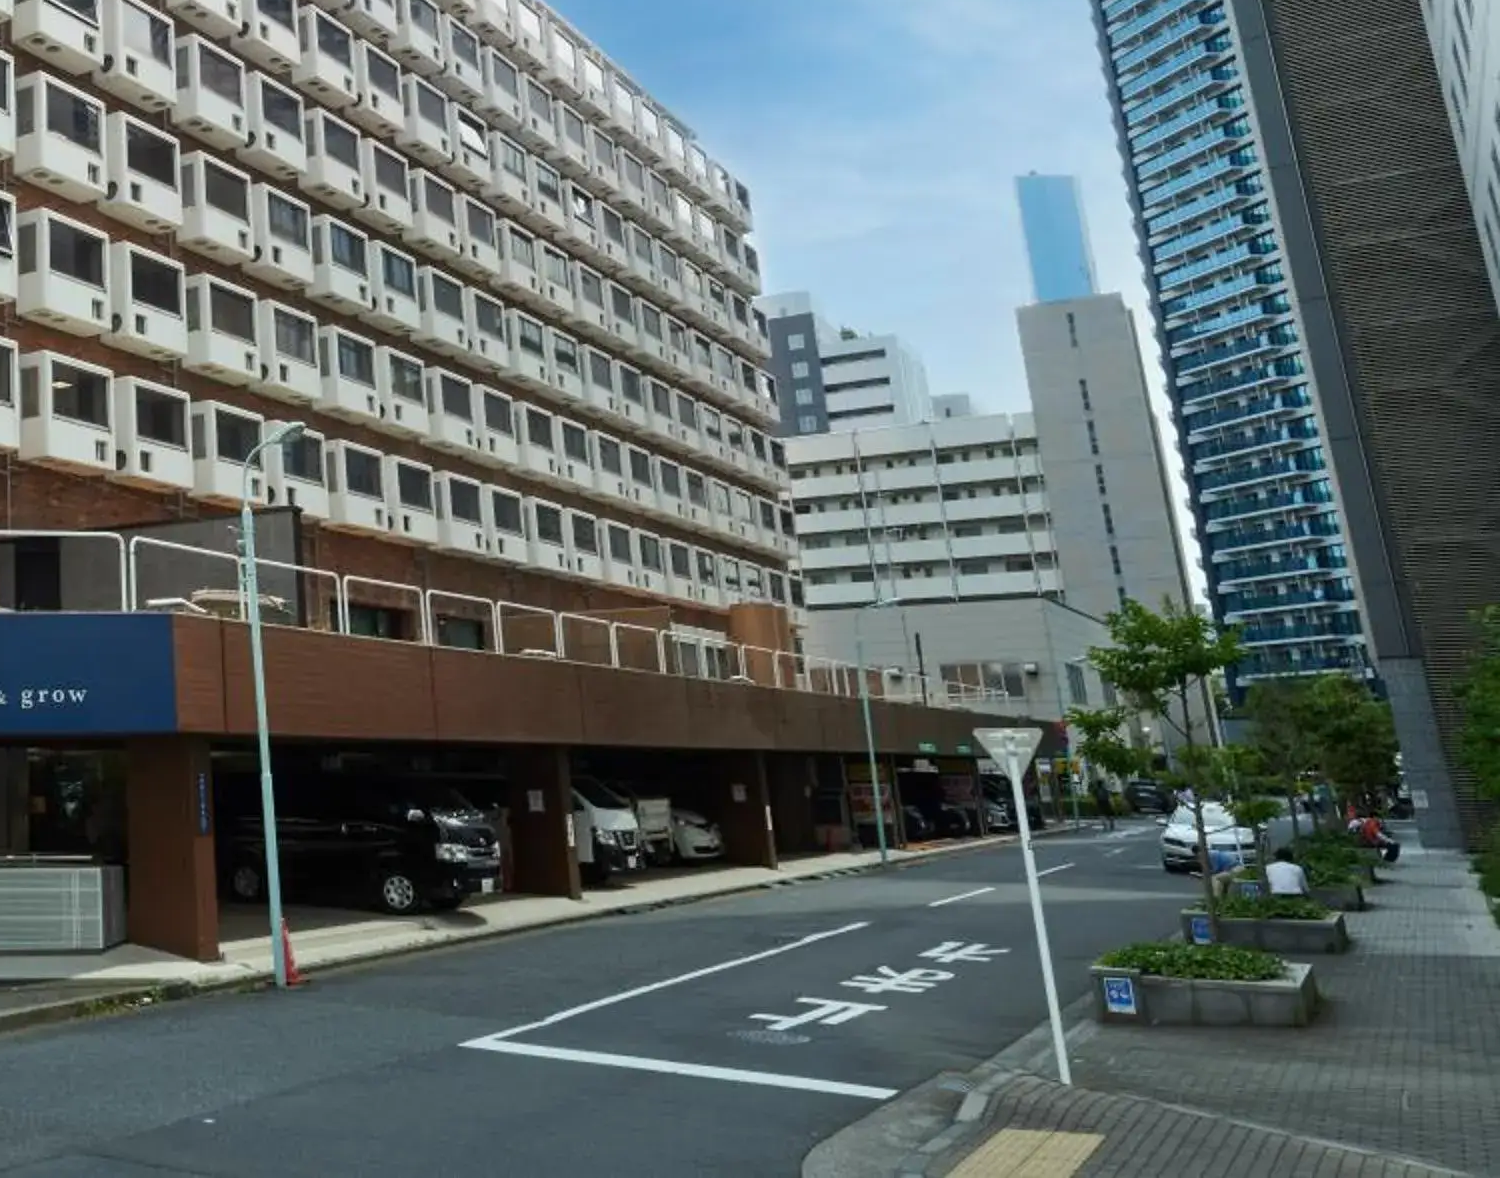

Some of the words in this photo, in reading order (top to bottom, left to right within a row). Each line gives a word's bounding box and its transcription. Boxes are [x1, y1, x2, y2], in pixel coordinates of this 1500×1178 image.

[21, 688, 88, 709] grow
[748, 940, 1012, 1031] 止まれ
